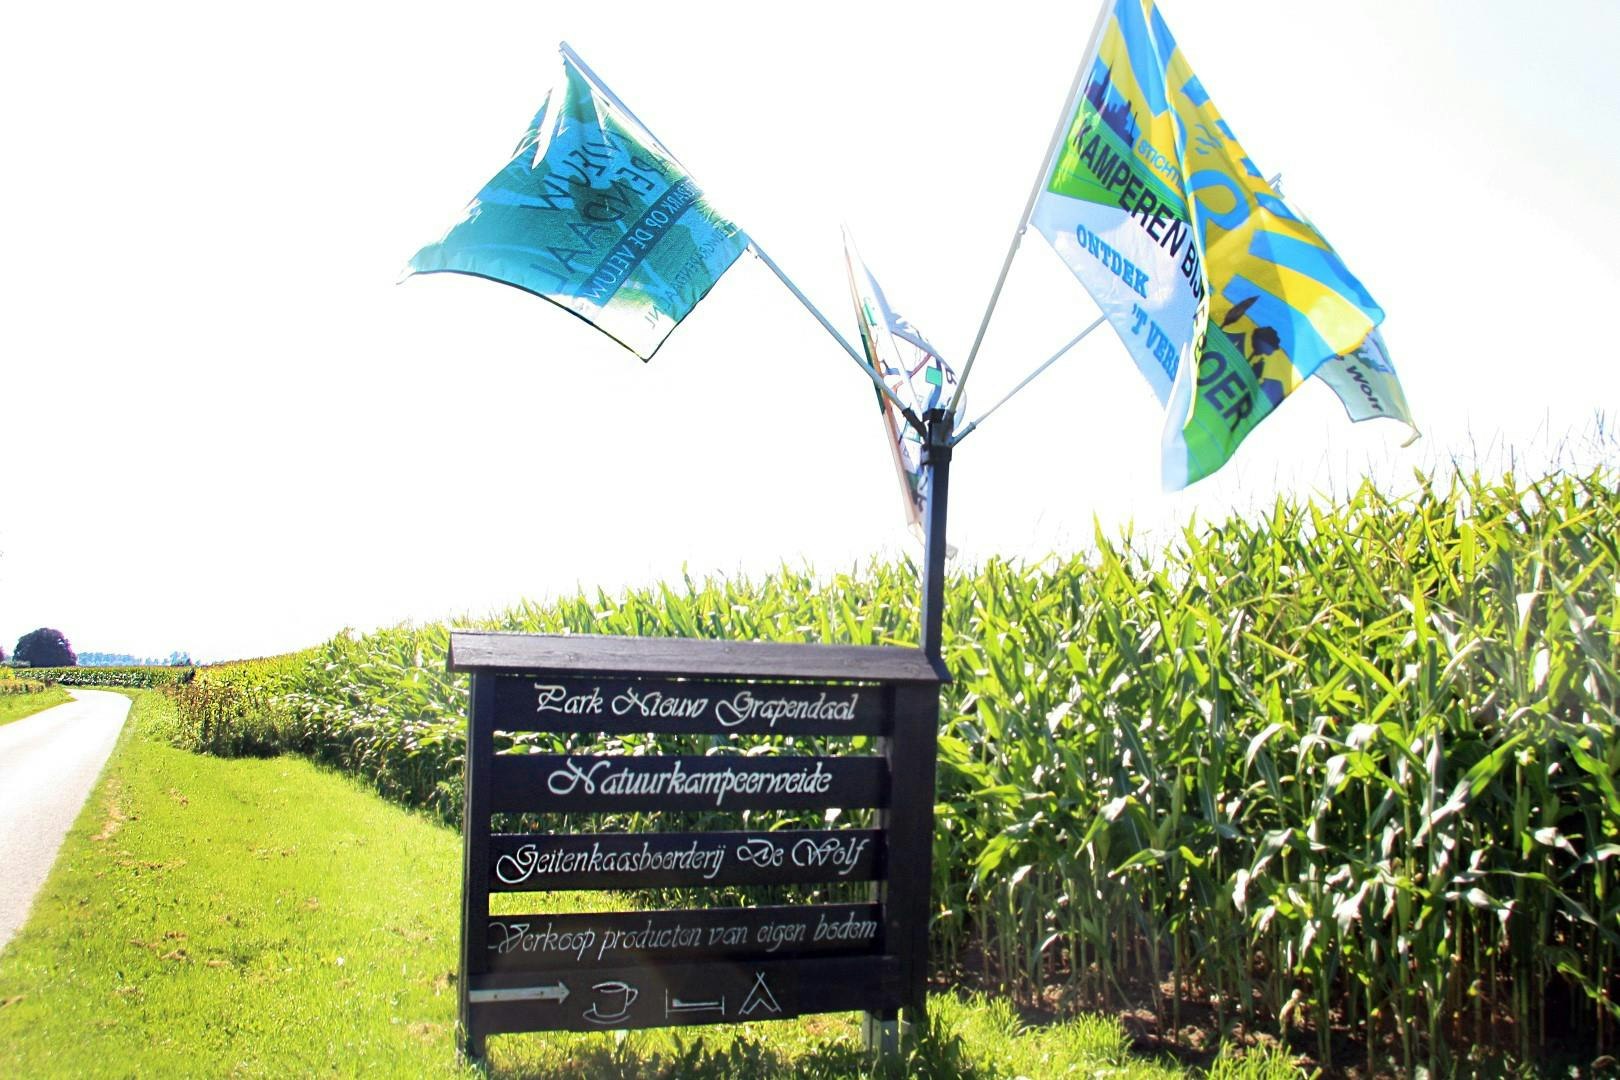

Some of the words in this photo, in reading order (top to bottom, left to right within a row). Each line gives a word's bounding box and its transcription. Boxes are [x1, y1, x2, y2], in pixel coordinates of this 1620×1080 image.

[1073, 118, 1187, 258] KAMPEREN
[1076, 223, 1149, 299] ONTDEK
[534, 682, 602, 714] Park
[611, 687, 708, 717] Nieuw
[715, 690, 859, 727] Grapendaal
[547, 757, 832, 805] Natuurkampeerweide
[496, 841, 727, 884] Geitenkaasboerderij
[736, 838, 784, 868] De
[791, 837, 870, 875] Wolf
[487, 921, 595, 961] Verkoop
[598, 919, 701, 961] producten
[708, 926, 748, 945] van
[757, 920, 804, 952] eigen
[813, 911, 877, 942] bodem
